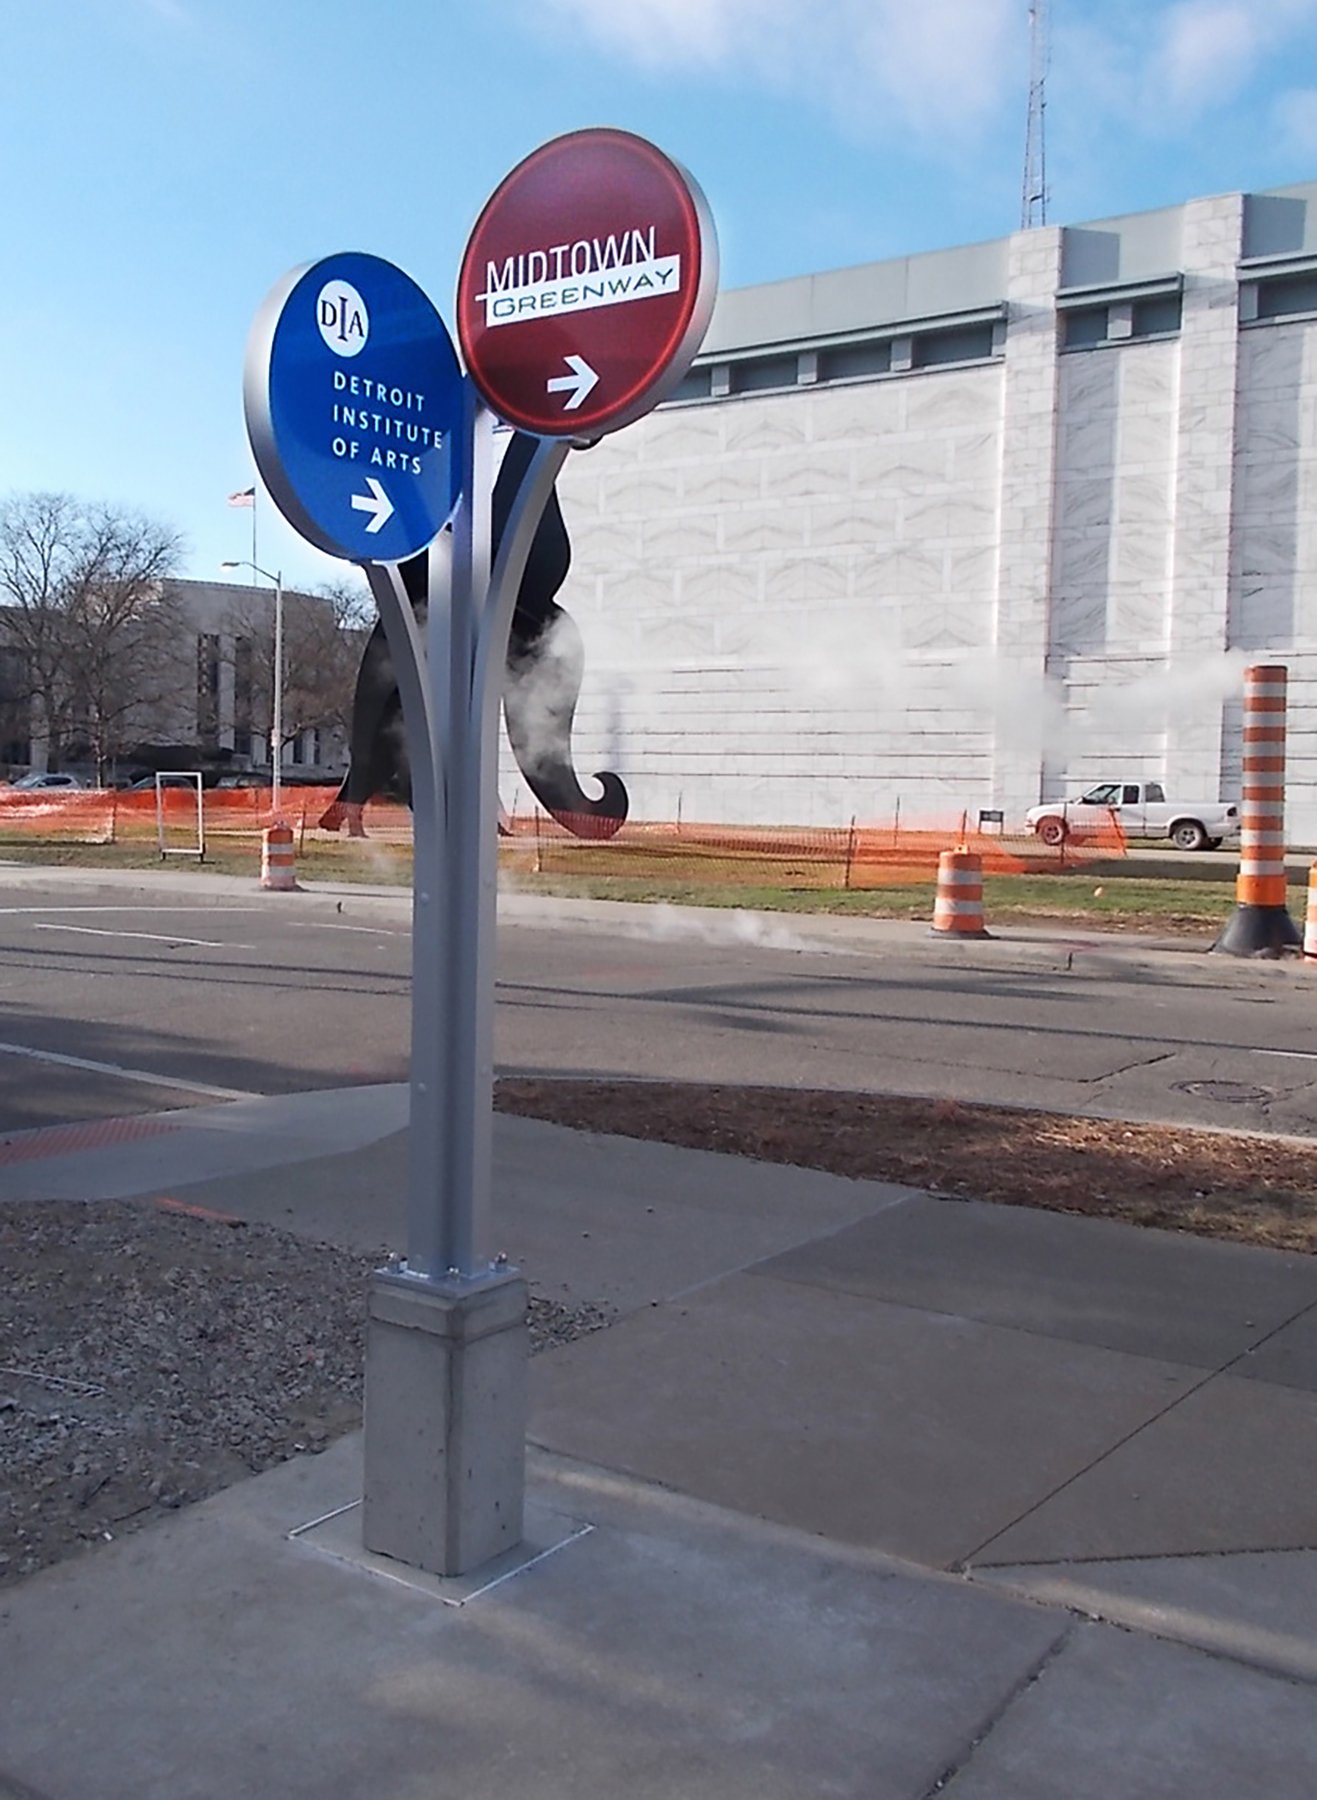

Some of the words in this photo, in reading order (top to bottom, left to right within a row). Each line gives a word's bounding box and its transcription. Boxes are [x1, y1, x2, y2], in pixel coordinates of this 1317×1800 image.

[486, 225, 656, 294] MIDTOWN
[491, 267, 674, 319] GREENWAY
[320, 295, 366, 343] DIA
[333, 370, 425, 412] DETROIT
[333, 404, 444, 450] INSTITUTE
[331, 436, 360, 460] OF
[370, 447, 423, 475] ARTS
